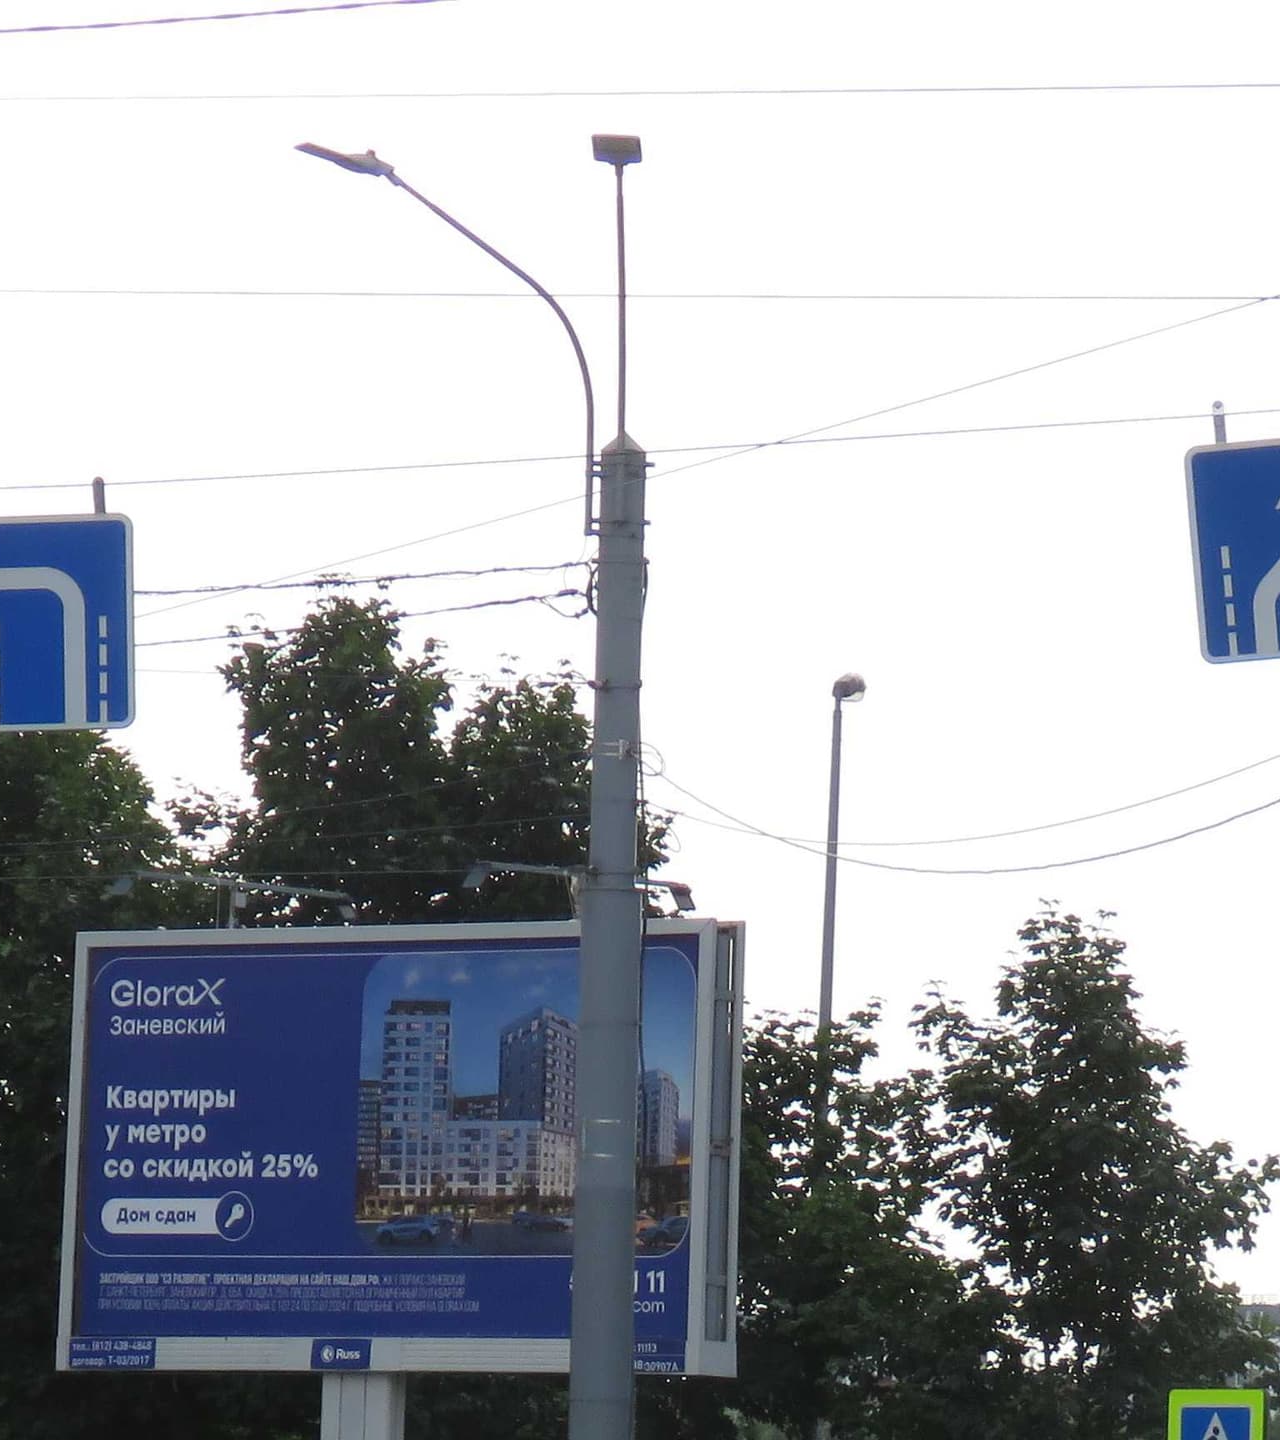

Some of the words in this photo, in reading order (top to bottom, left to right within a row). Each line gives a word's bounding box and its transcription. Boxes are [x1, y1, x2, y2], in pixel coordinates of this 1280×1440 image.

[111, 978, 226, 1007] GloraX
[110, 1011, 225, 1035] Заневский
[106, 1085, 236, 1116] Квартиры
[105, 1124, 120, 1151] у
[127, 1124, 207, 1151] метро
[103, 1158, 135, 1178] со
[142, 1151, 253, 1182] скидкой
[261, 1154, 319, 1178] 25%
[116, 1207, 150, 1225] Дом
[155, 1209, 196, 1225] сдан
[646, 1270, 665, 1293] 11
[633, 1301, 664, 1312] com
[336, 1348, 360, 1360] Russ
